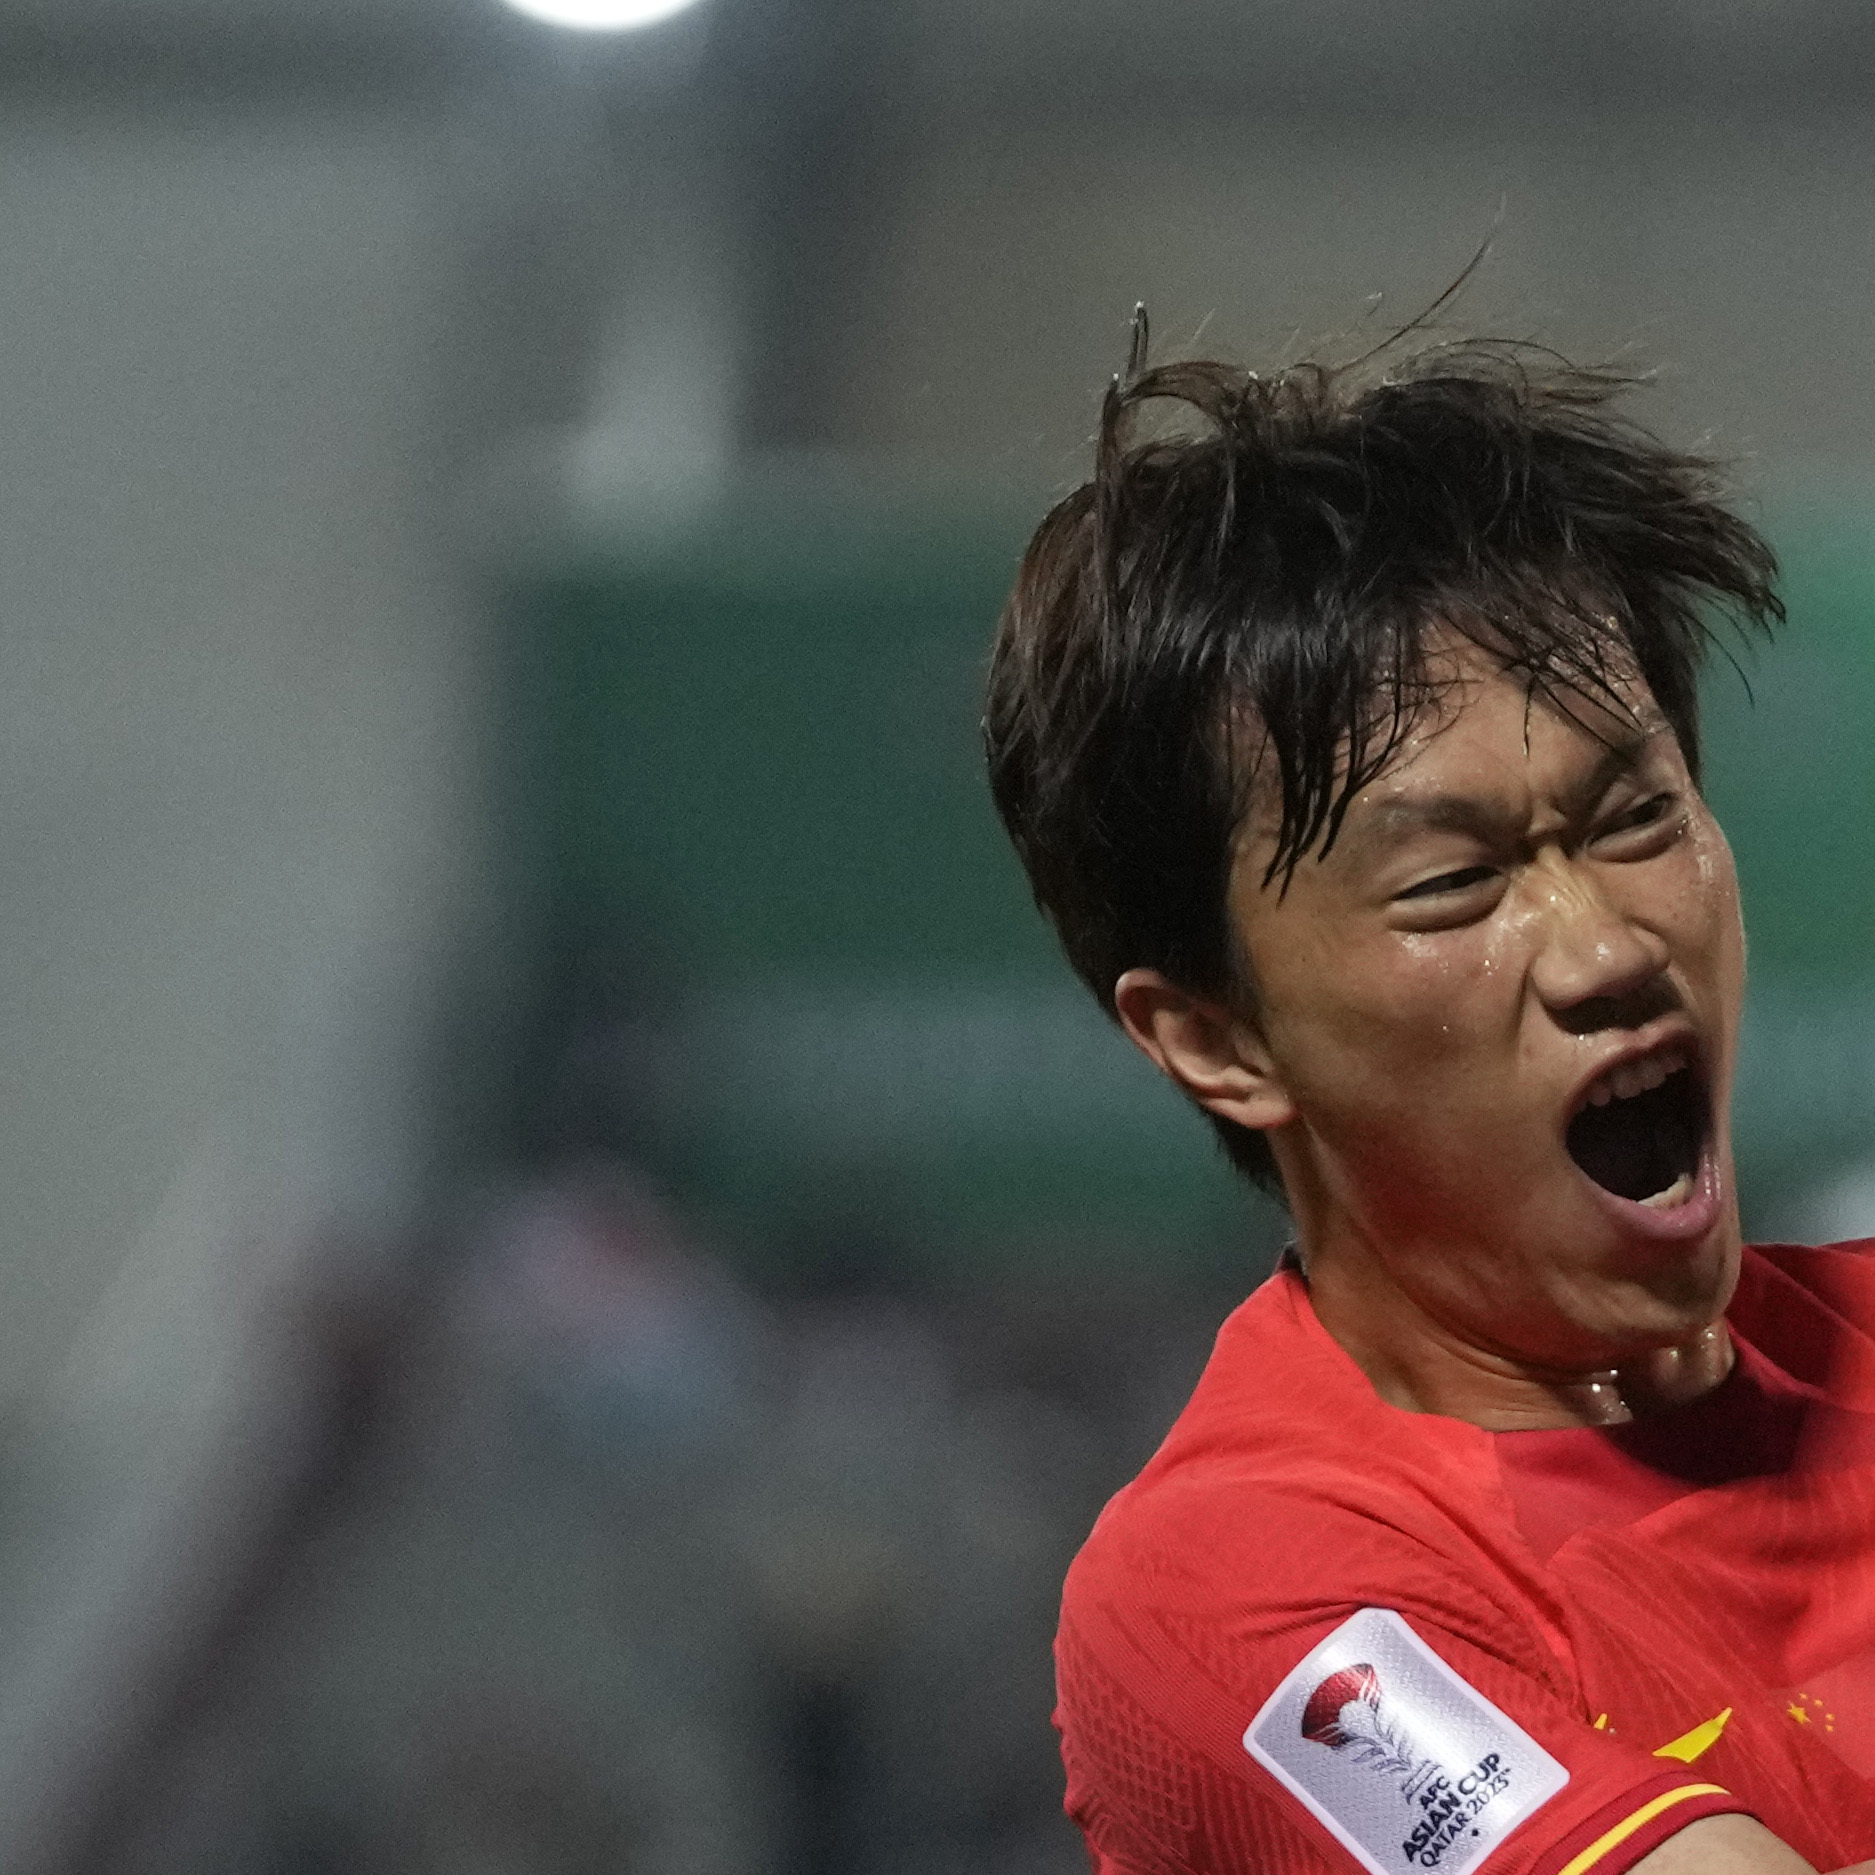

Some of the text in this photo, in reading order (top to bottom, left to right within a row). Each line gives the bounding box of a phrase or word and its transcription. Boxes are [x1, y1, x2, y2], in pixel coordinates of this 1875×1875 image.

[1402, 1753, 1500, 1863] ASIAN CUP
[1420, 1775, 1450, 1810] AFC
[1420, 1812, 1473, 1867] QATAR
